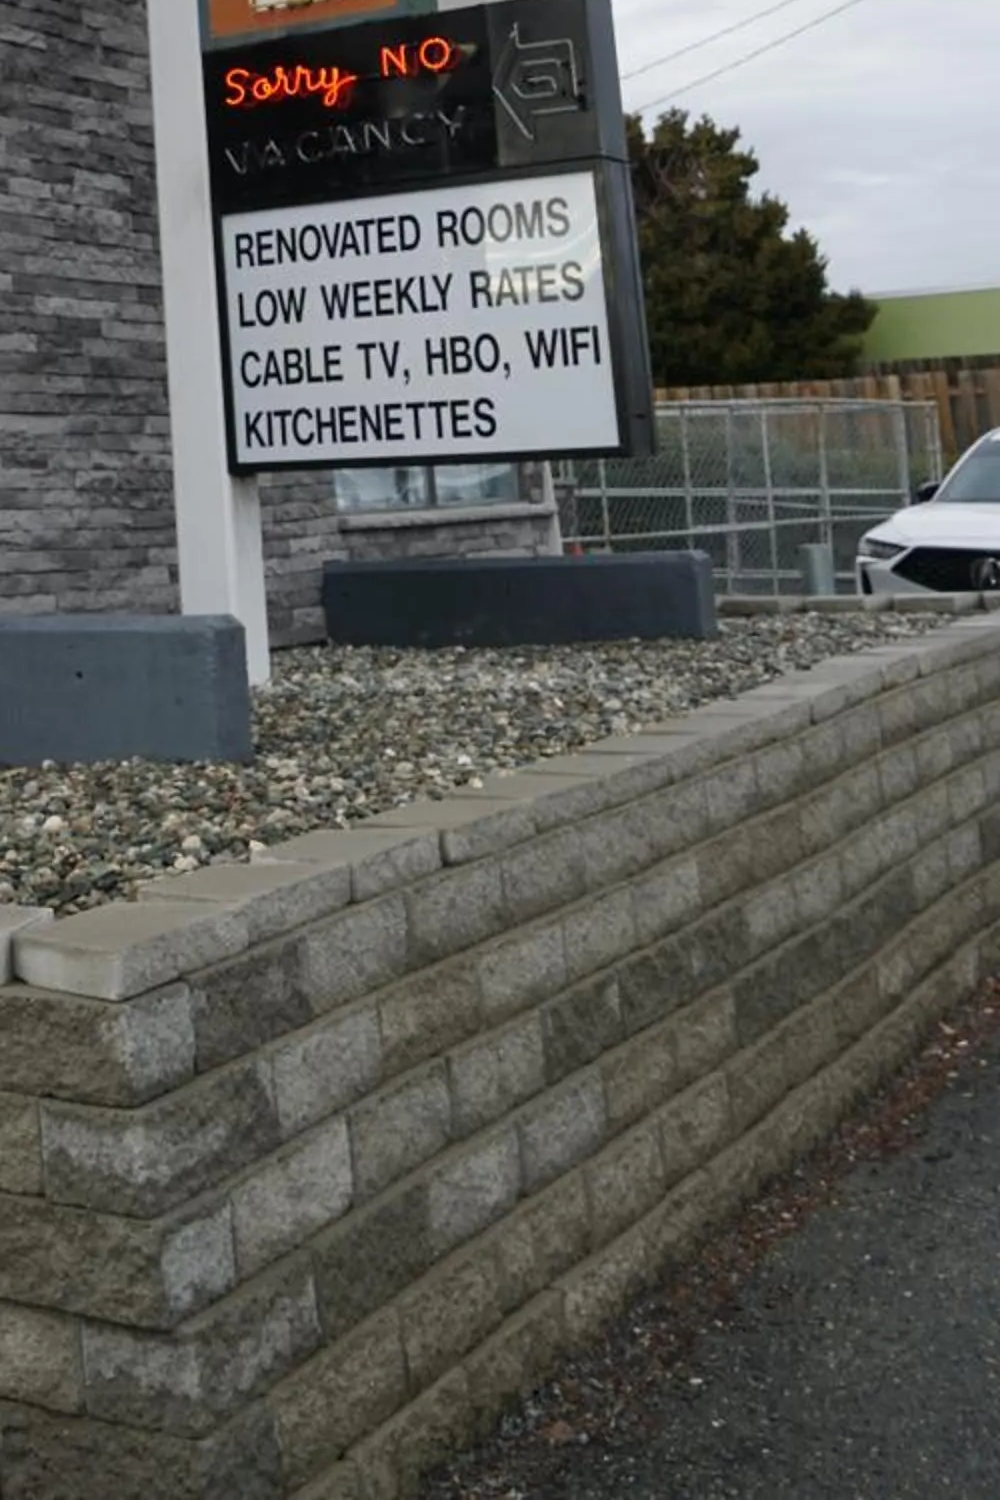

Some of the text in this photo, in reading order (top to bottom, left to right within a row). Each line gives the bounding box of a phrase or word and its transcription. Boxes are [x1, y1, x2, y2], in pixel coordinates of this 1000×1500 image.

[224, 37, 451, 107] Sorry NO
[224, 105, 466, 175] VACANCY
[234, 197, 571, 269] RENOVATED ROOMS
[238, 261, 586, 328] LOW WEEKLY RATES
[240, 325, 602, 389] CABLE TV, HBO, WIFI
[244, 397, 498, 449] KITCHENETTES
